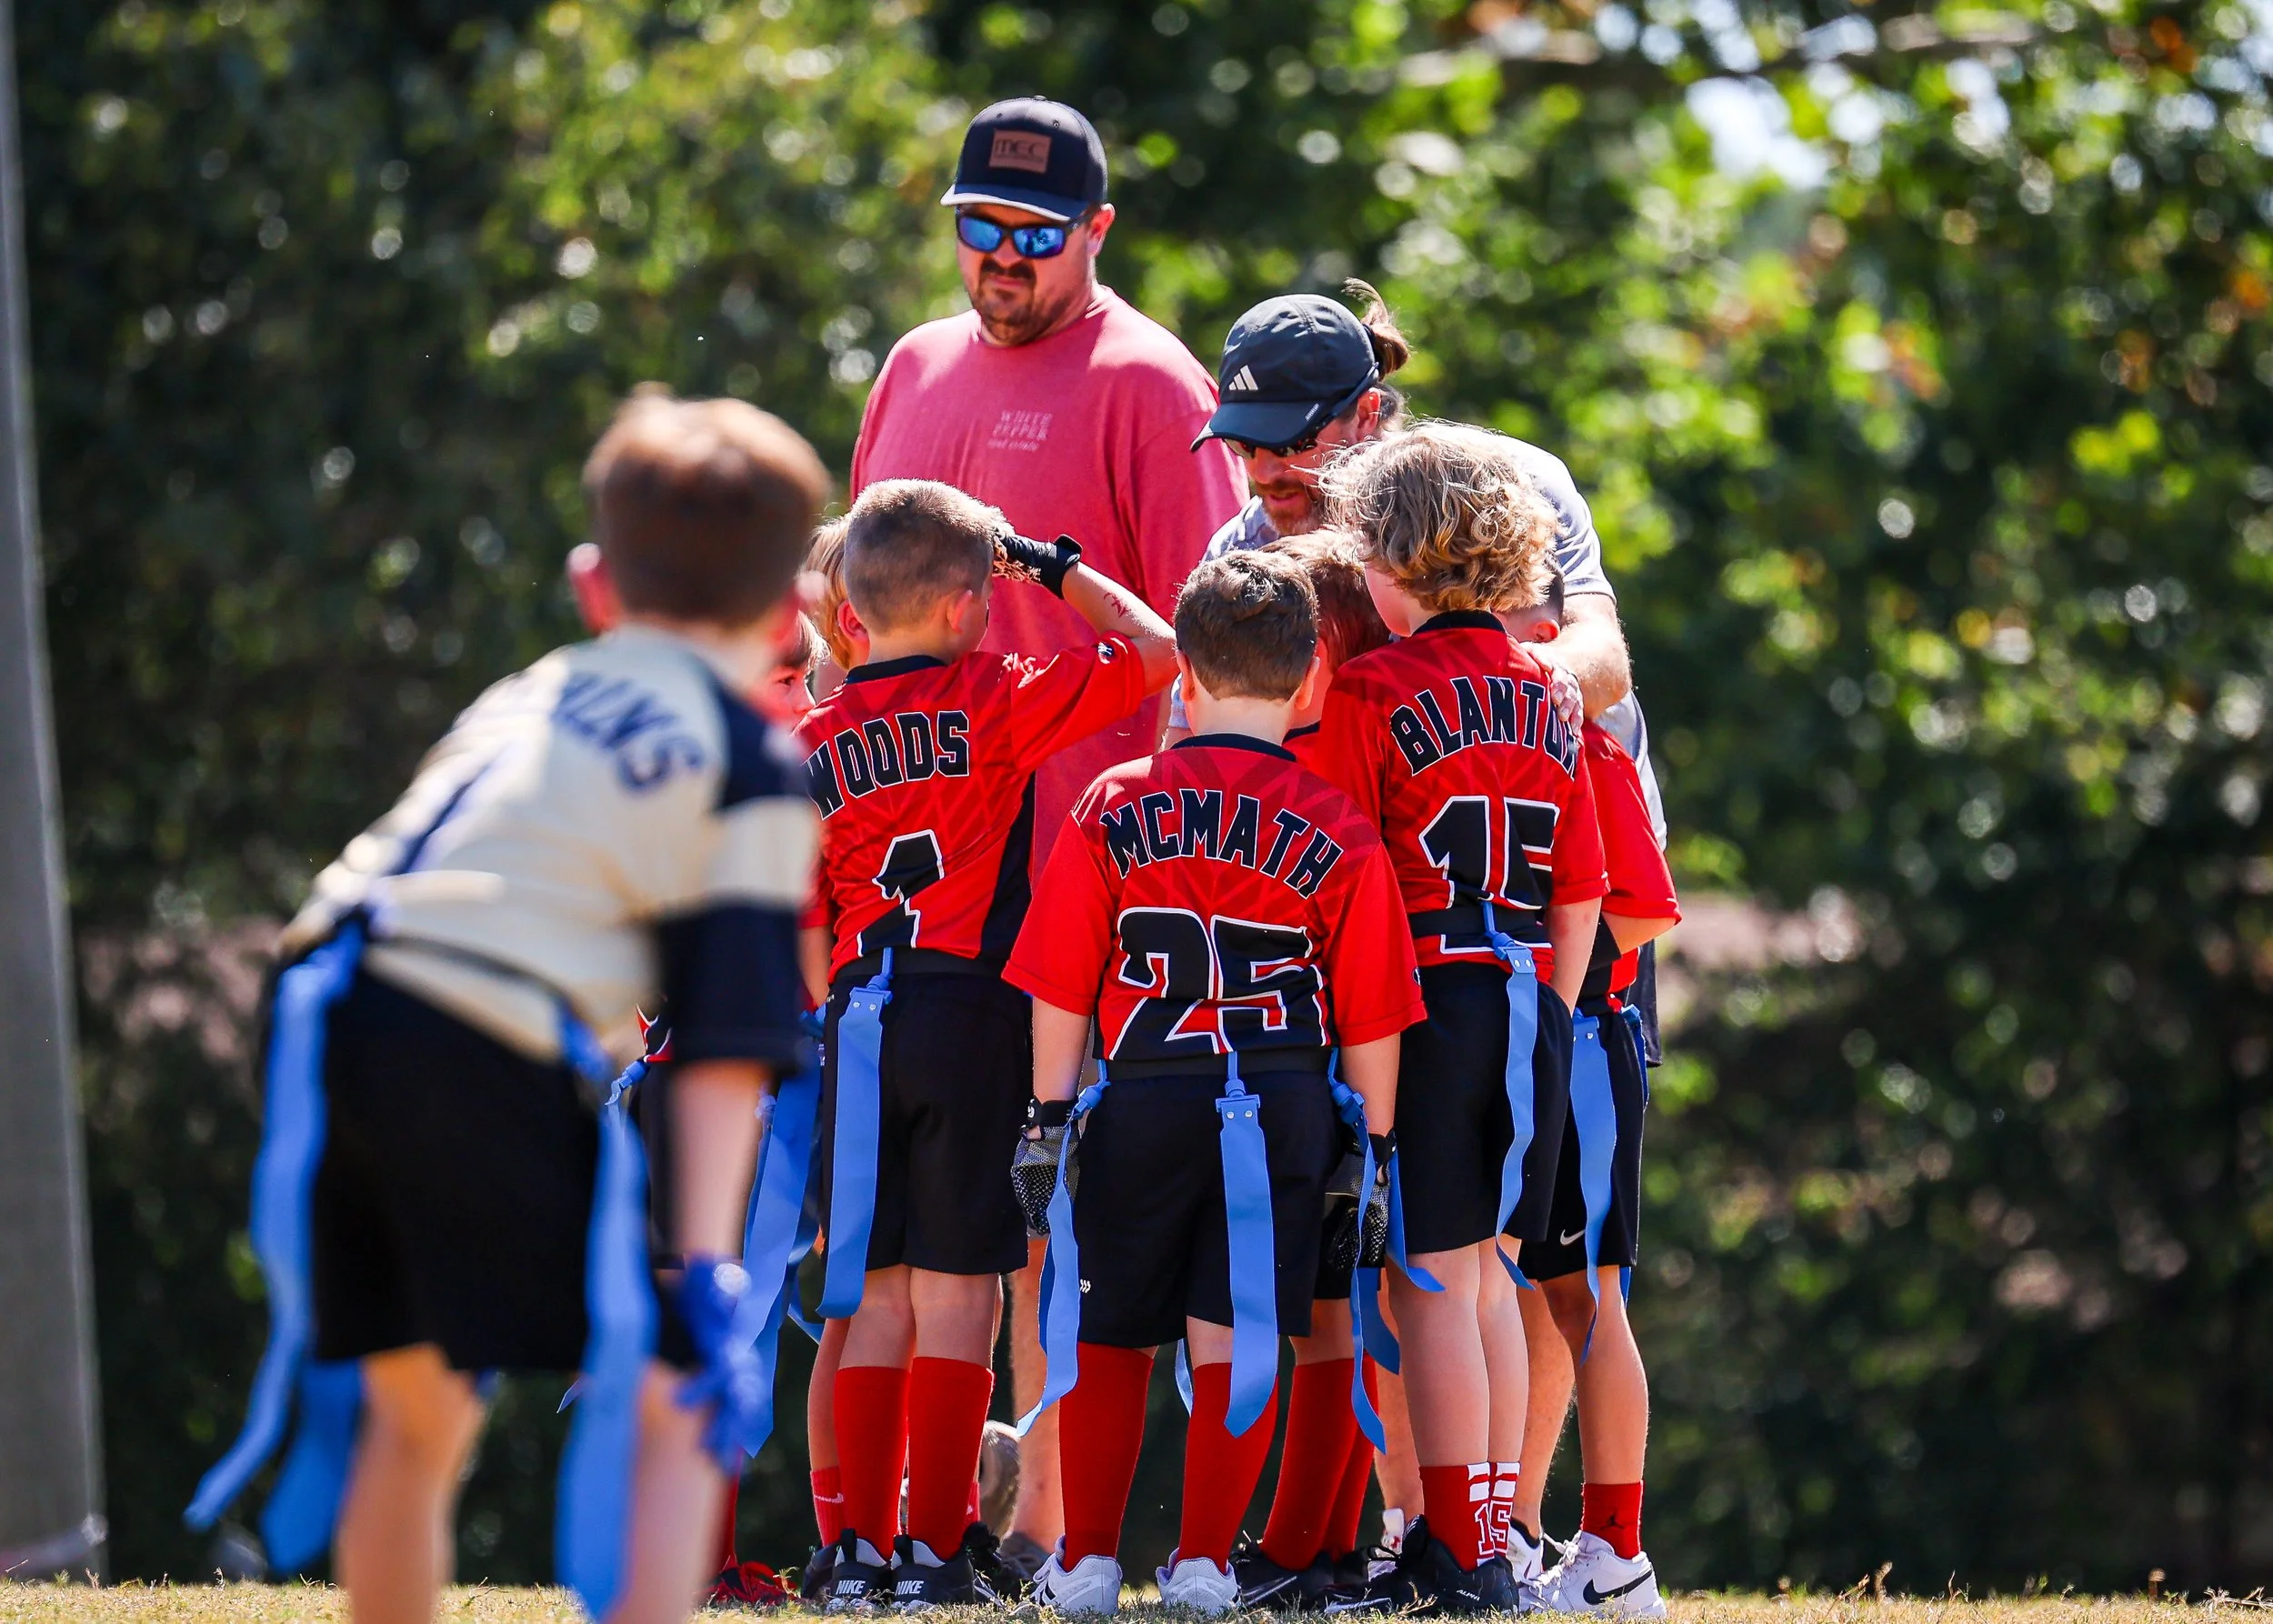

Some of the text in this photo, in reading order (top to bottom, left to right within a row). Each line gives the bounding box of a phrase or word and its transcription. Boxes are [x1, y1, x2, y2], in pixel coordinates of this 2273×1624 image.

[801, 710, 969, 820] WOODS
[872, 828, 945, 957] 1
[1099, 788, 1344, 899] MCMATH
[1418, 795, 1560, 955] 15
[1115, 907, 1331, 1060] 25
[1474, 1499, 1513, 1555] 15
[836, 1580, 866, 1595] NIKE
[895, 1580, 925, 1596] NIKE
[1457, 1589, 1480, 1601] ALPHA
